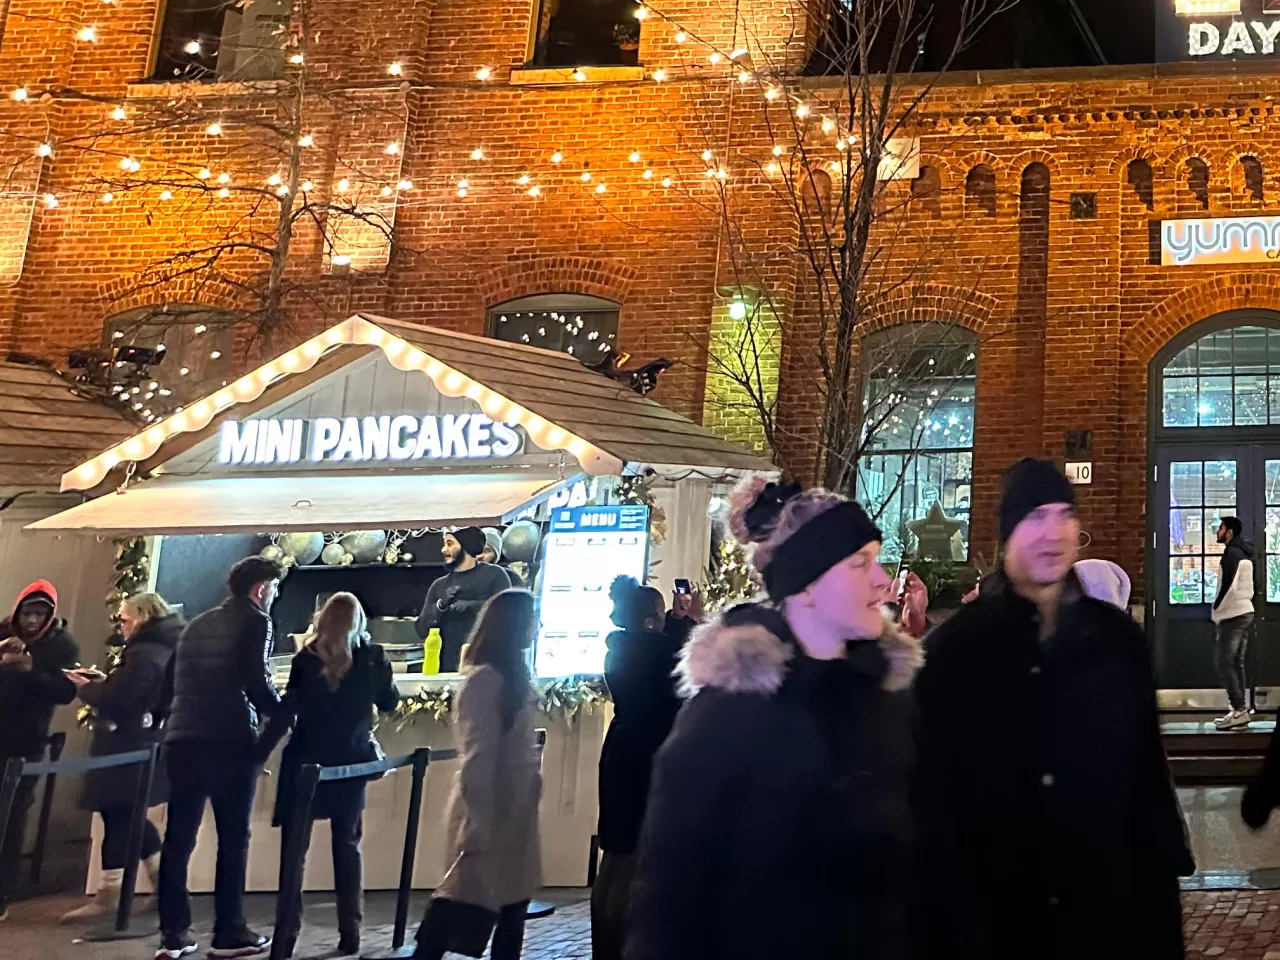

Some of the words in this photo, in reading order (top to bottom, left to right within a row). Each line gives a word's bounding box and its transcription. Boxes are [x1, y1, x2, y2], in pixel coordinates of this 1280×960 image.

[219, 418, 303, 464] MINI
[311, 413, 521, 464] PANCAKES
[1076, 466, 1090, 480] 10
[580, 512, 617, 527] MENU
